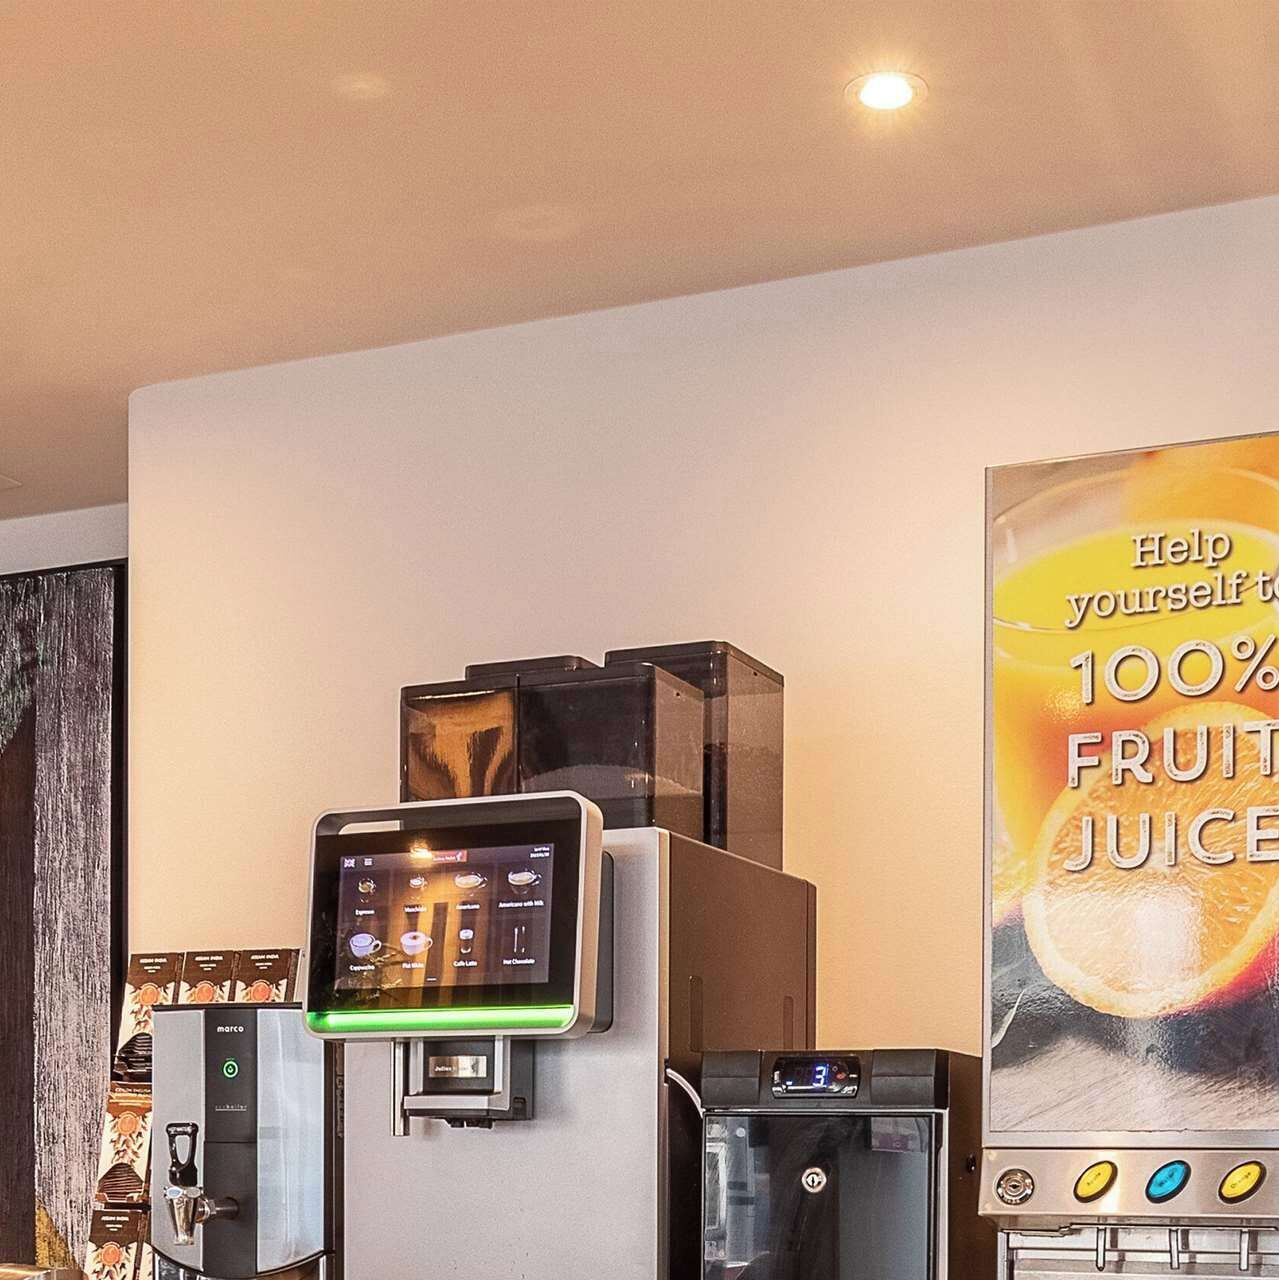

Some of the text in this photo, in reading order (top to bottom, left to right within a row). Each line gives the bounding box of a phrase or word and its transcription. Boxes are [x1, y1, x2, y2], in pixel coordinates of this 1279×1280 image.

[1130, 529, 1232, 568] Help
[1064, 571, 1248, 628] yourself
[813, 1065, 826, 1087] 3
